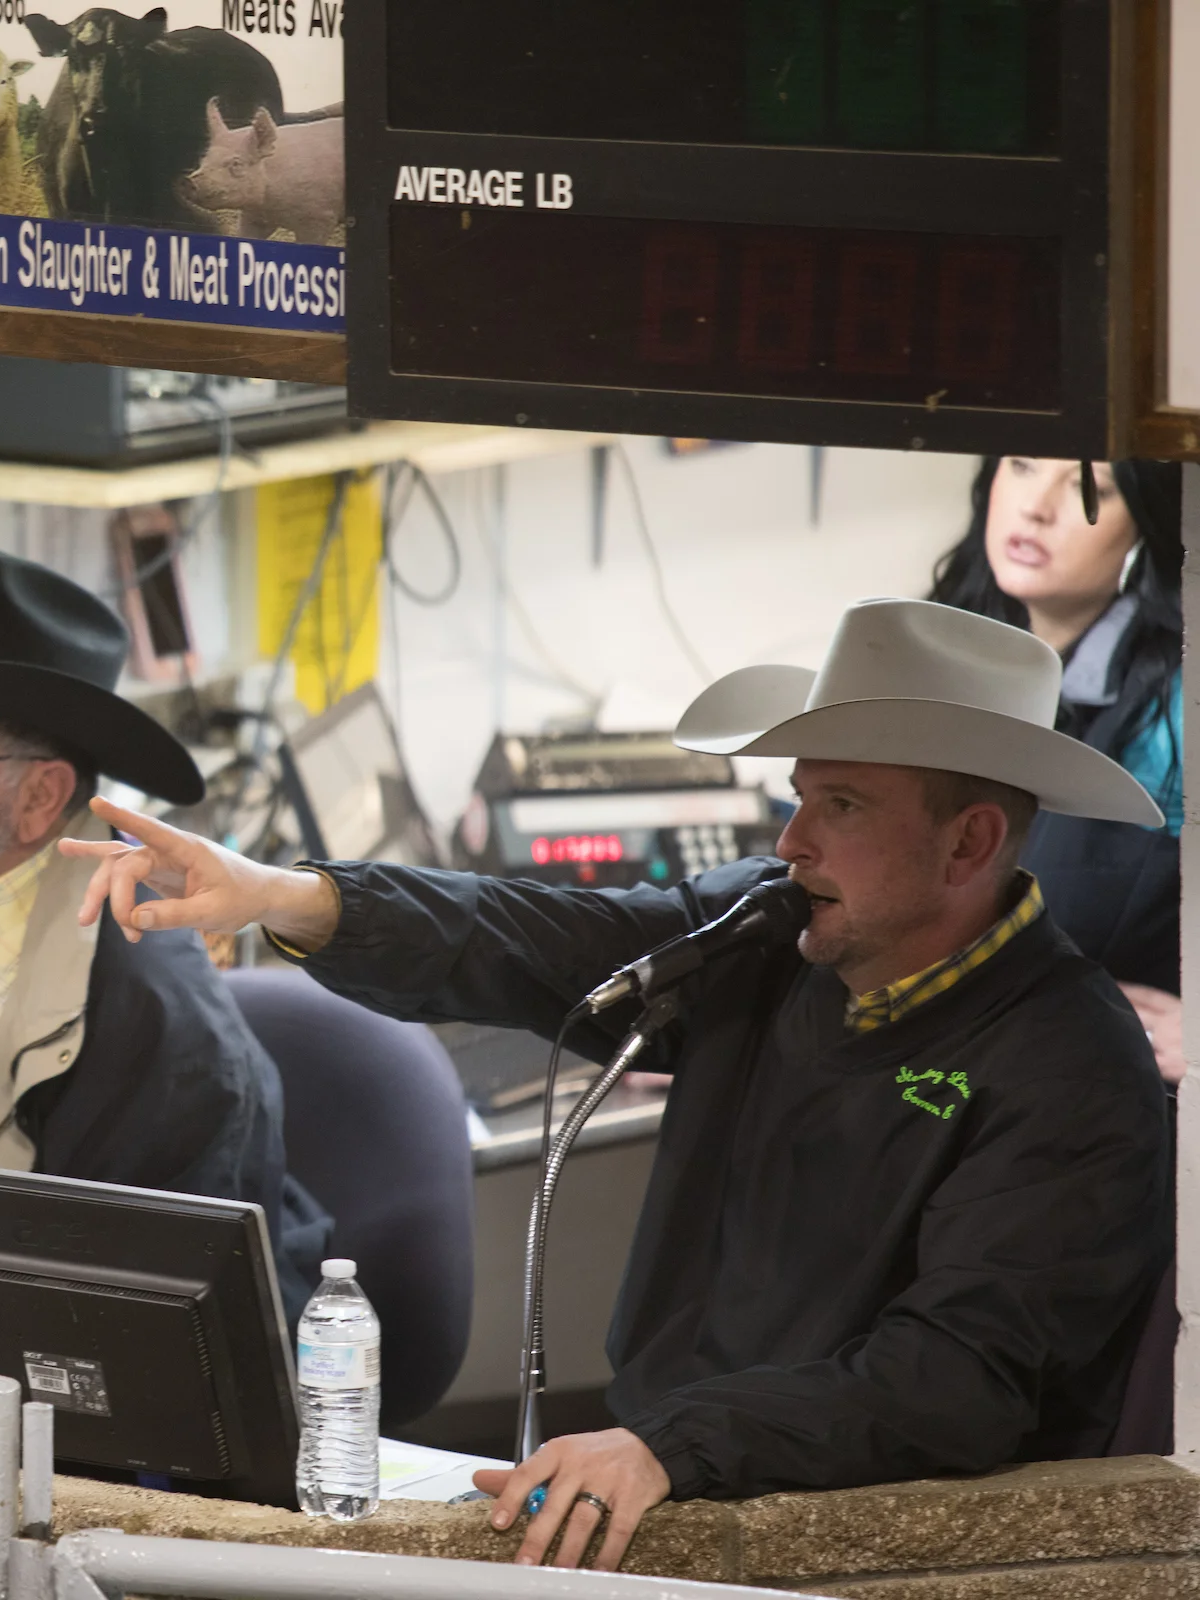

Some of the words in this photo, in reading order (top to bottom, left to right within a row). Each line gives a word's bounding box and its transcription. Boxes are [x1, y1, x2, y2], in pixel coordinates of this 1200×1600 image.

[222, 0, 296, 37] Meats
[394, 165, 525, 207] AVERAGE
[535, 172, 574, 210] LB
[17, 219, 133, 307] Slaughter
[141, 235, 161, 299] &
[169, 235, 230, 306] Meat
